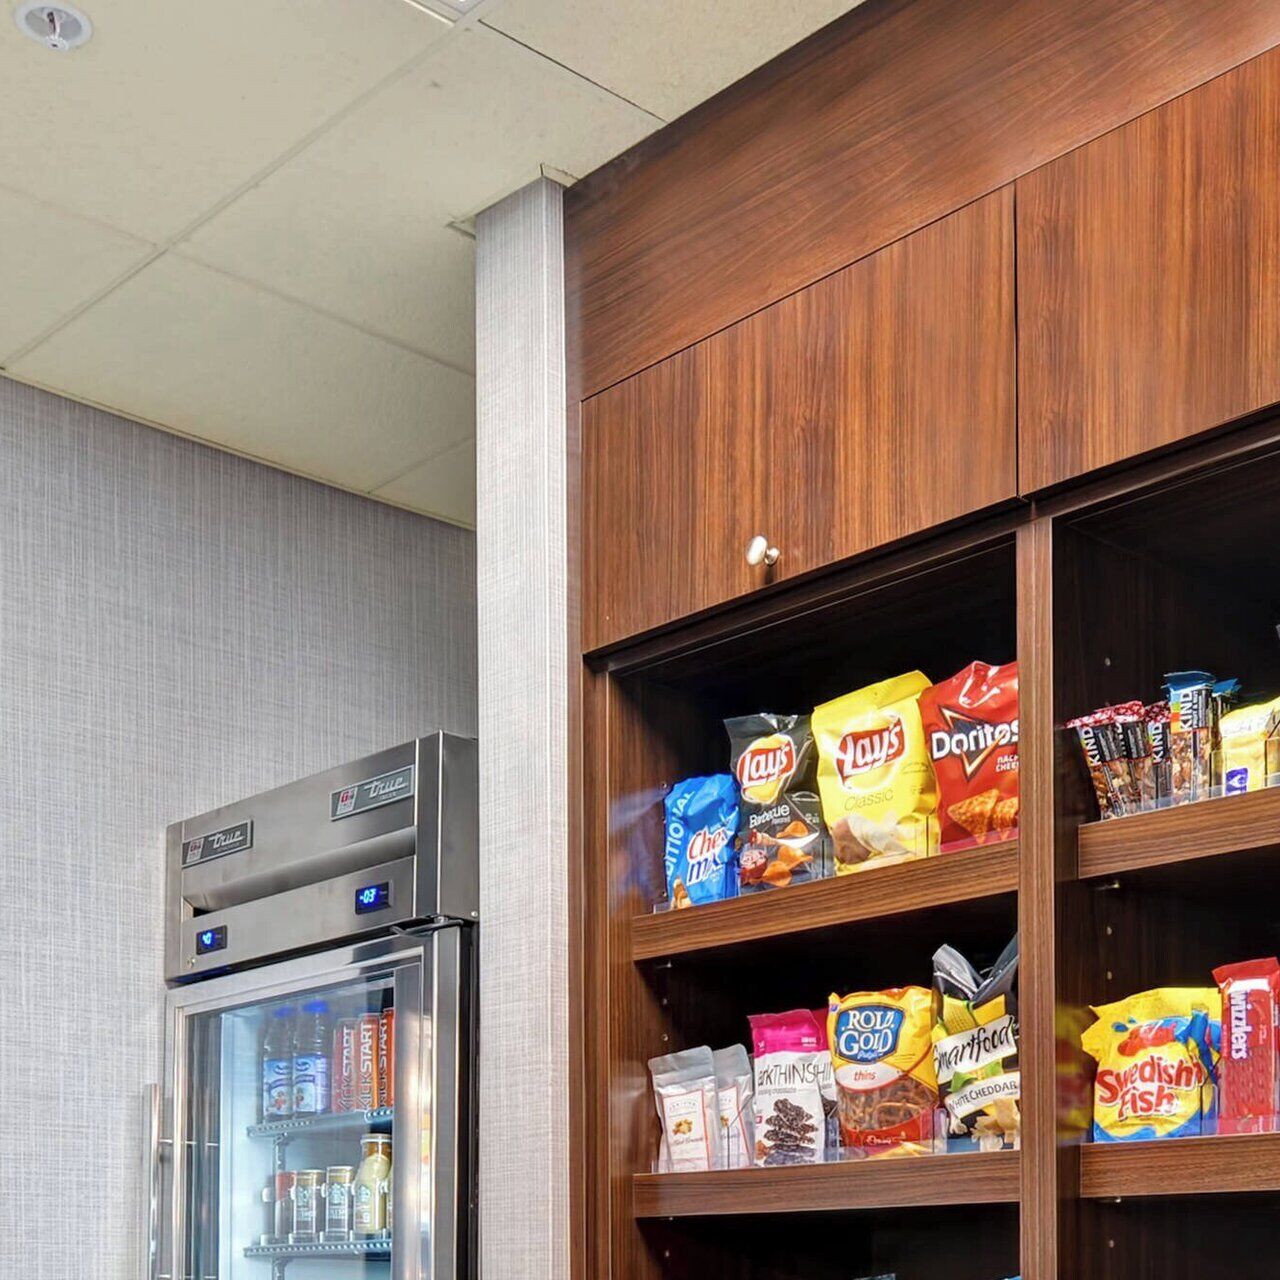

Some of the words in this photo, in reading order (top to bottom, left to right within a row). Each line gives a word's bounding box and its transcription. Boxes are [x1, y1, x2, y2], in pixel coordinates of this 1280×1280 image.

[1179, 690, 1193, 731] KIND
[837, 724, 903, 777] Lay's
[1082, 726, 1102, 766] KIND
[1152, 723, 1165, 764] KIND
[741, 744, 796, 785] Lay's
[364, 776, 409, 798] true
[844, 789, 894, 812] Classic
[749, 803, 790, 829] Barbecue
[208, 831, 245, 848] true
[839, 1030, 893, 1056] GOLD
[359, 1021, 373, 1112] KICKSTART
[853, 1069, 876, 1081] thins
[1096, 1051, 1204, 1105] Swedish
[969, 1079, 1018, 1101] CHEDDAR
[1119, 1082, 1180, 1120] Fish
